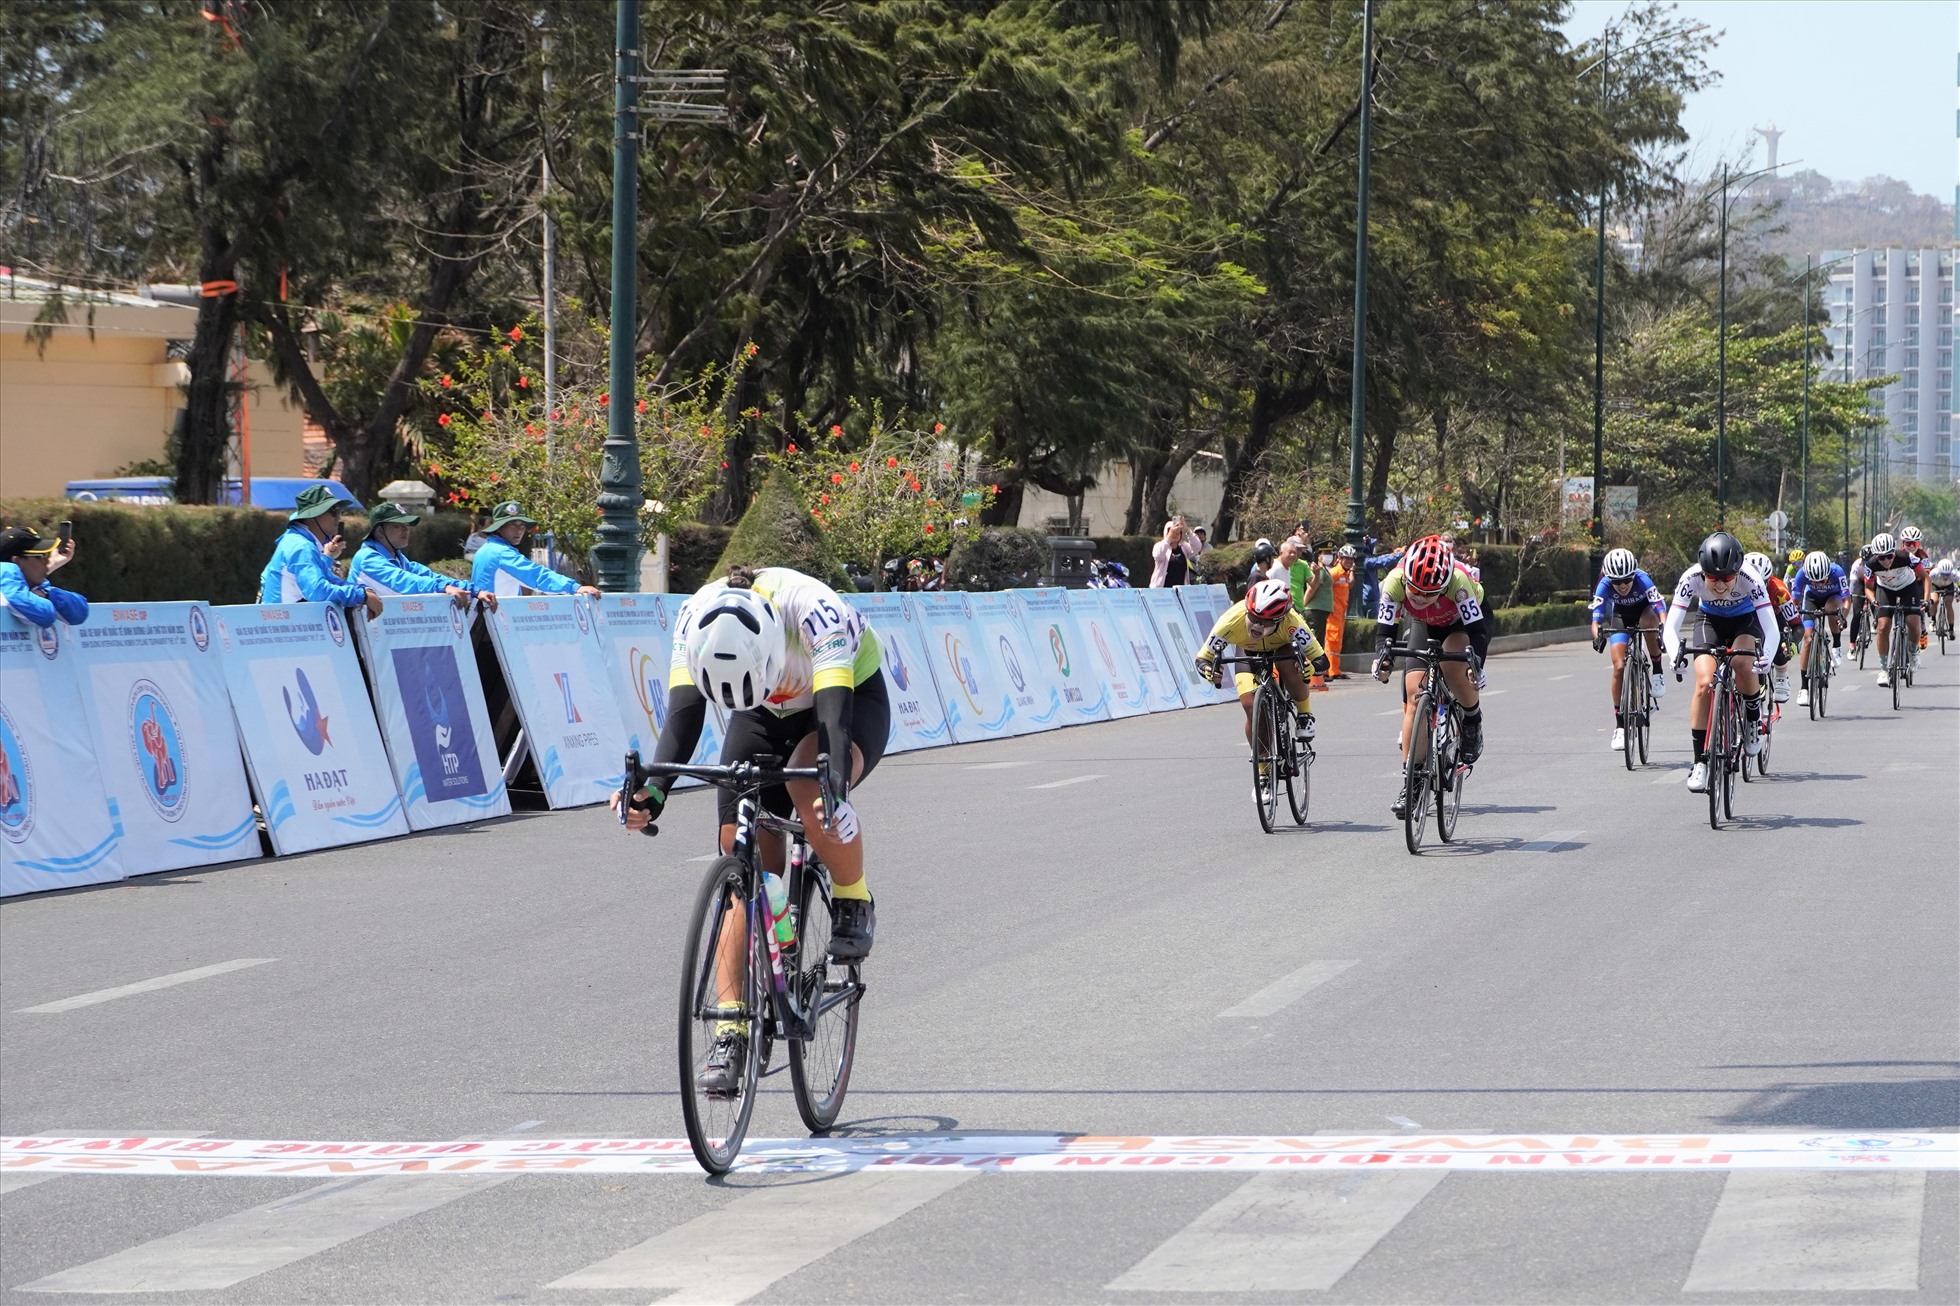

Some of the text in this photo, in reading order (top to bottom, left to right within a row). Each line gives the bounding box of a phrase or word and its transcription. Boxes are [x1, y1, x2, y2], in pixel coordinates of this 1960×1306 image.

[1460, 600, 1480, 620] 85
[1782, 602, 1798, 618] 102
[442, 753, 459, 775] HTP
